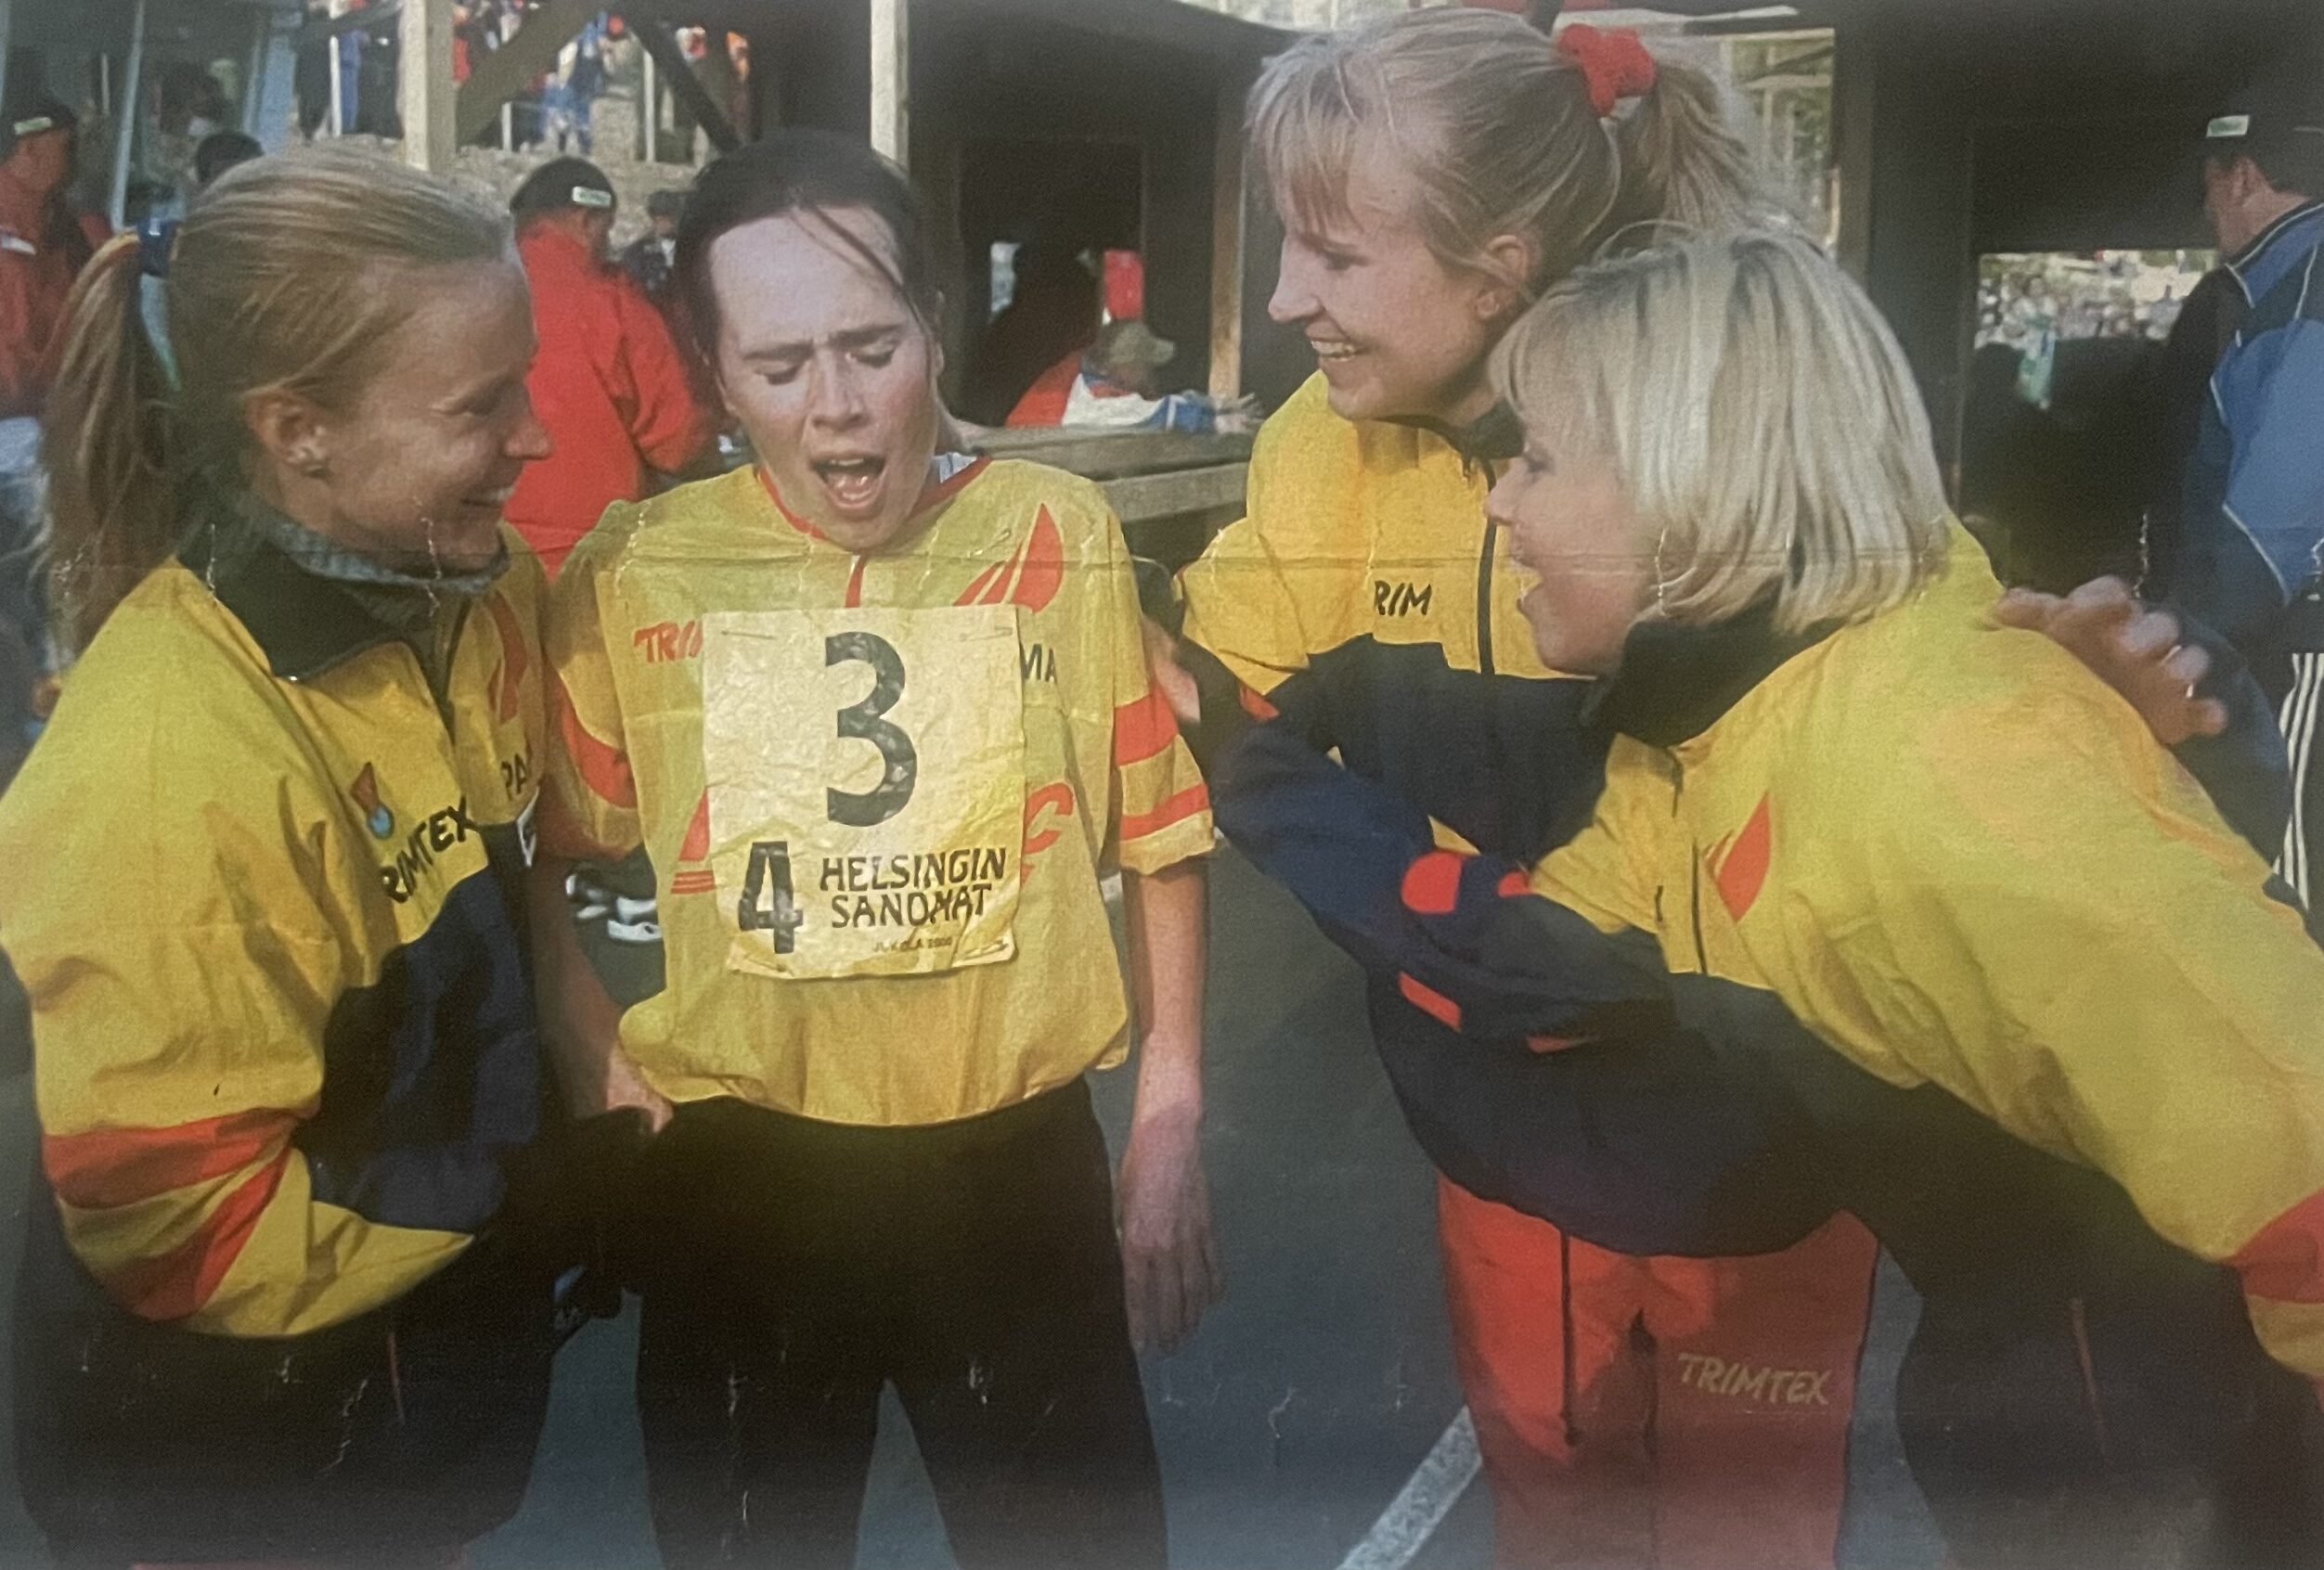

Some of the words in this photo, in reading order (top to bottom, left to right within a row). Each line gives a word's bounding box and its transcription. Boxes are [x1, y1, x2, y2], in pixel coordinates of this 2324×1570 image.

[1375, 580, 1432, 617] RIM
[825, 631, 918, 828] 3
[820, 847, 1007, 892] HELSINGIN
[737, 841, 804, 955] 4
[1678, 1352, 1833, 1407] TRIMTEX
